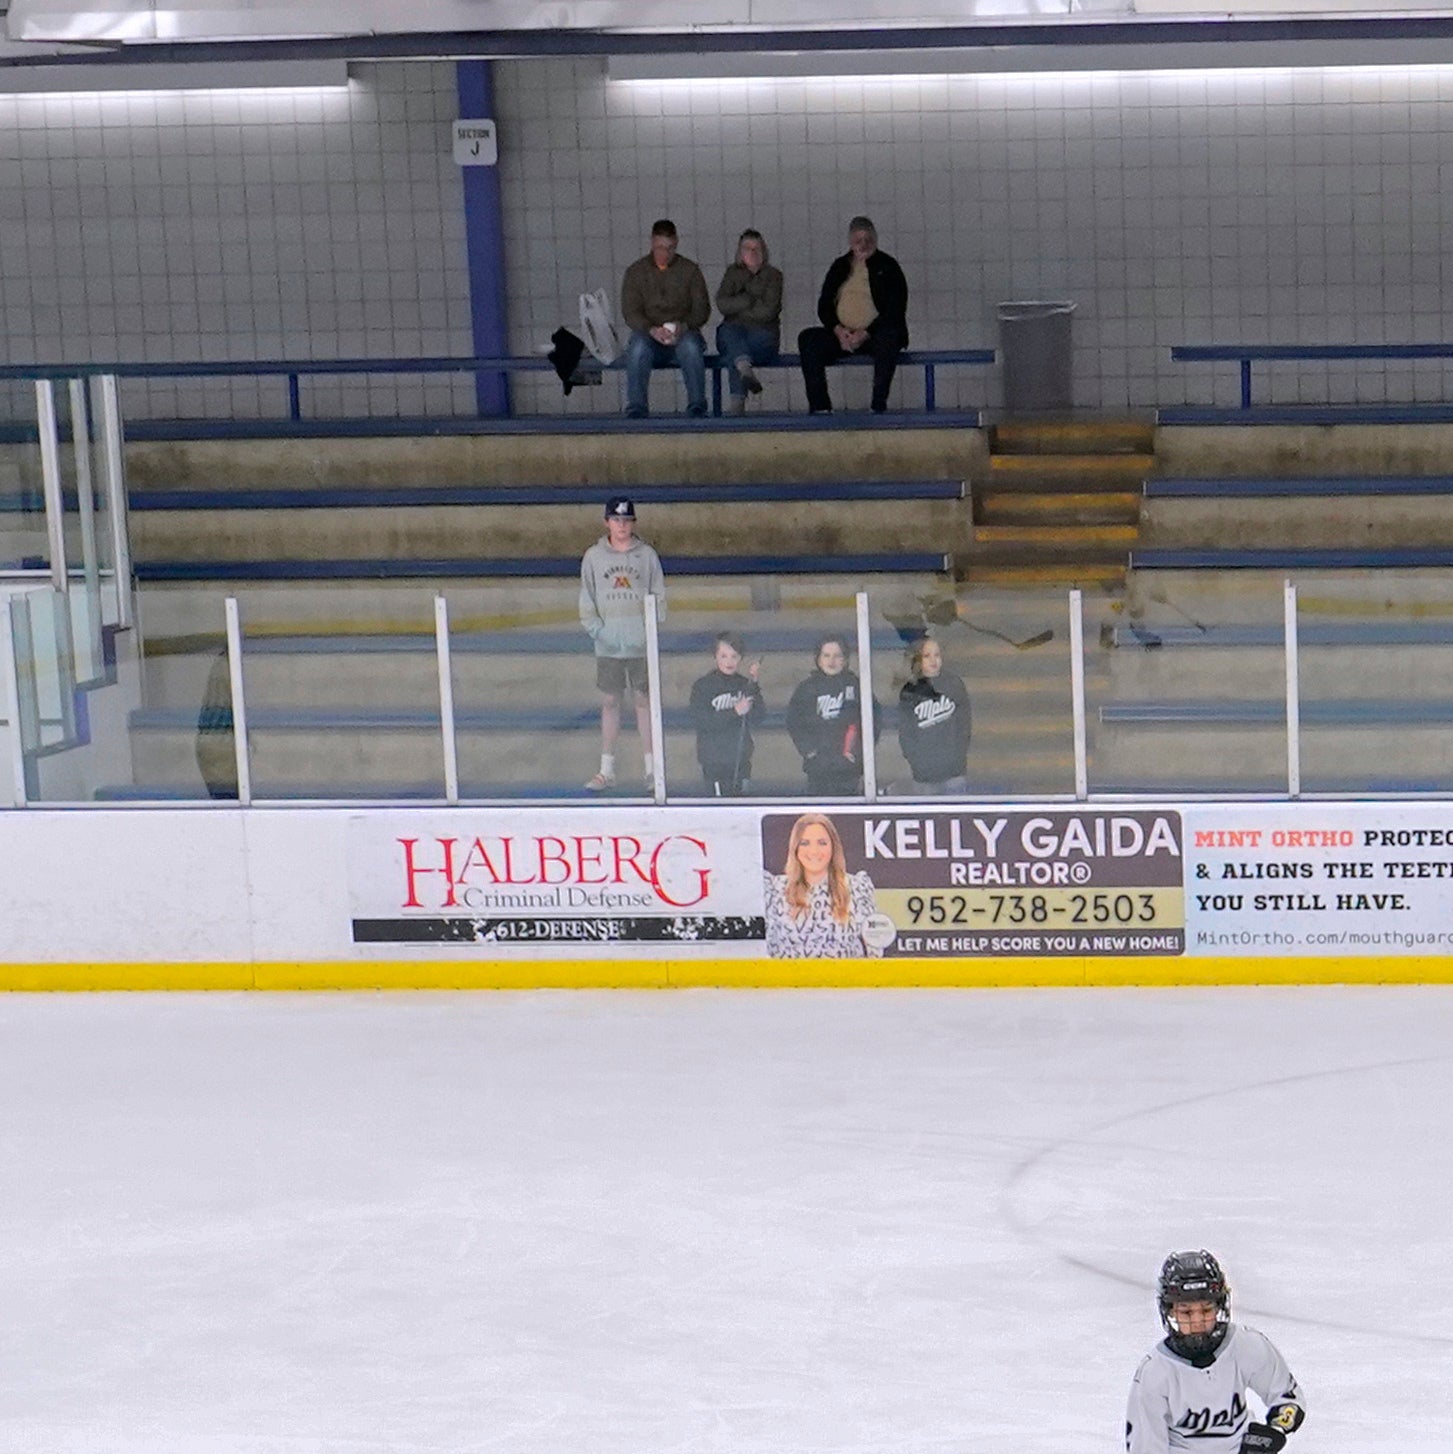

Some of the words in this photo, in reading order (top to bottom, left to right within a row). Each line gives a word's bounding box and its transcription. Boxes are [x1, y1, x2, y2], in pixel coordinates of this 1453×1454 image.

[458, 129, 489, 139] SECTION
[470, 141, 479, 156] J
[863, 818, 1007, 859] KELLY
[1021, 817, 1180, 858] GAIDA
[1194, 830, 1262, 847] MINT
[1272, 830, 1354, 847] ORTHO
[396, 835, 713, 908] HALBERG
[1196, 862, 1211, 879] &
[1222, 862, 1314, 879] ALIGNS
[1323, 862, 1374, 879] THE
[463, 887, 561, 908] Criminal
[568, 887, 652, 908] Defense
[1196, 894, 1244, 911] YOU
[1254, 894, 1326, 911] STILL
[1337, 894, 1411, 911] HAVE.
[907, 894, 1157, 925] 952-738-2503
[496, 920, 620, 938] 612-DEFENSE
[898, 937, 920, 952] LET
[923, 937, 948, 952] ME
[951, 937, 989, 952] HELP
[992, 937, 1042, 952] SCORE
[1045, 937, 1077, 952] YOU
[1079, 937, 1093, 952] A
[1094, 937, 1126, 952] NEW
[1129, 937, 1179, 952] HOME!
